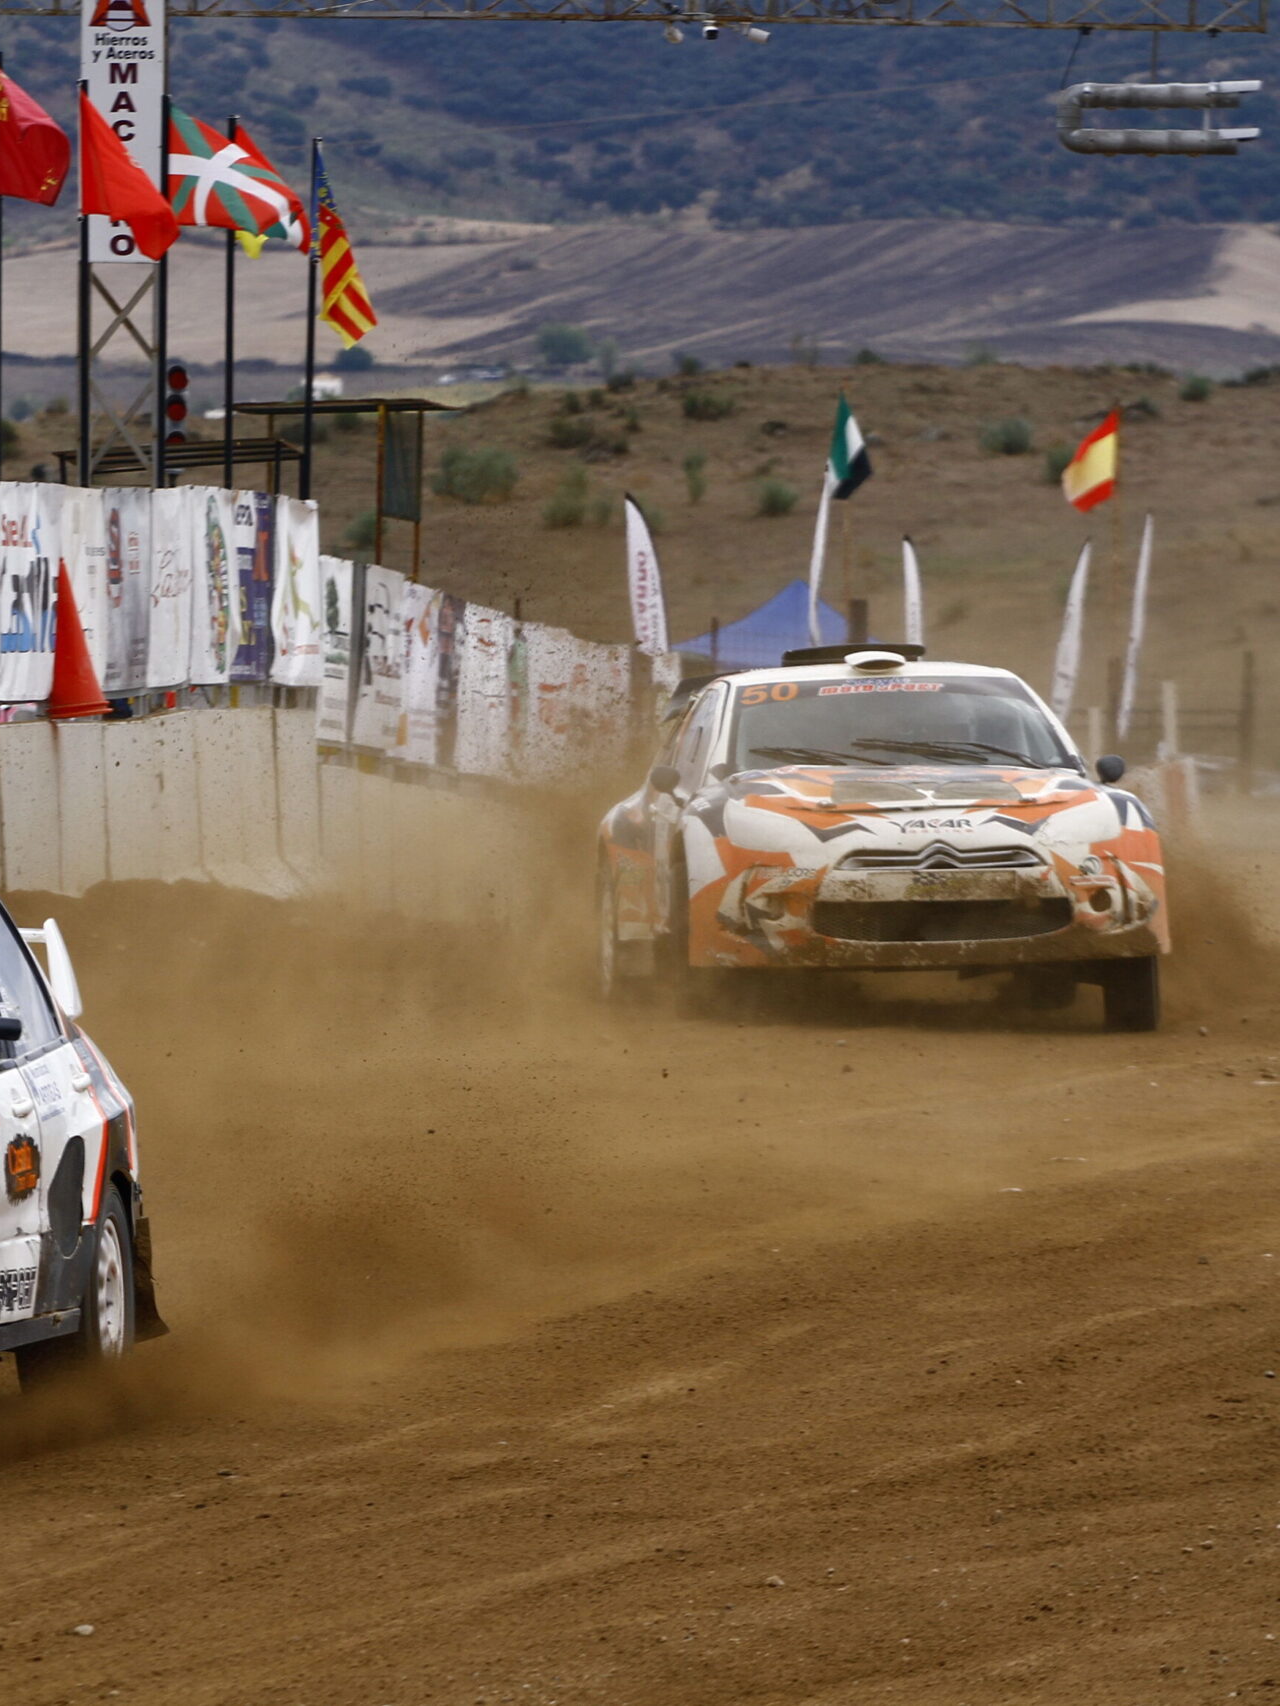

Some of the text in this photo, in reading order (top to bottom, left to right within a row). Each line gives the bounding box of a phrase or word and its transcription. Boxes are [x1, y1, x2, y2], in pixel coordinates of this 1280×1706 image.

[95, 33, 148, 46] Hierros
[92, 47, 156, 63] y Aceros
[741, 683, 799, 705] 50
